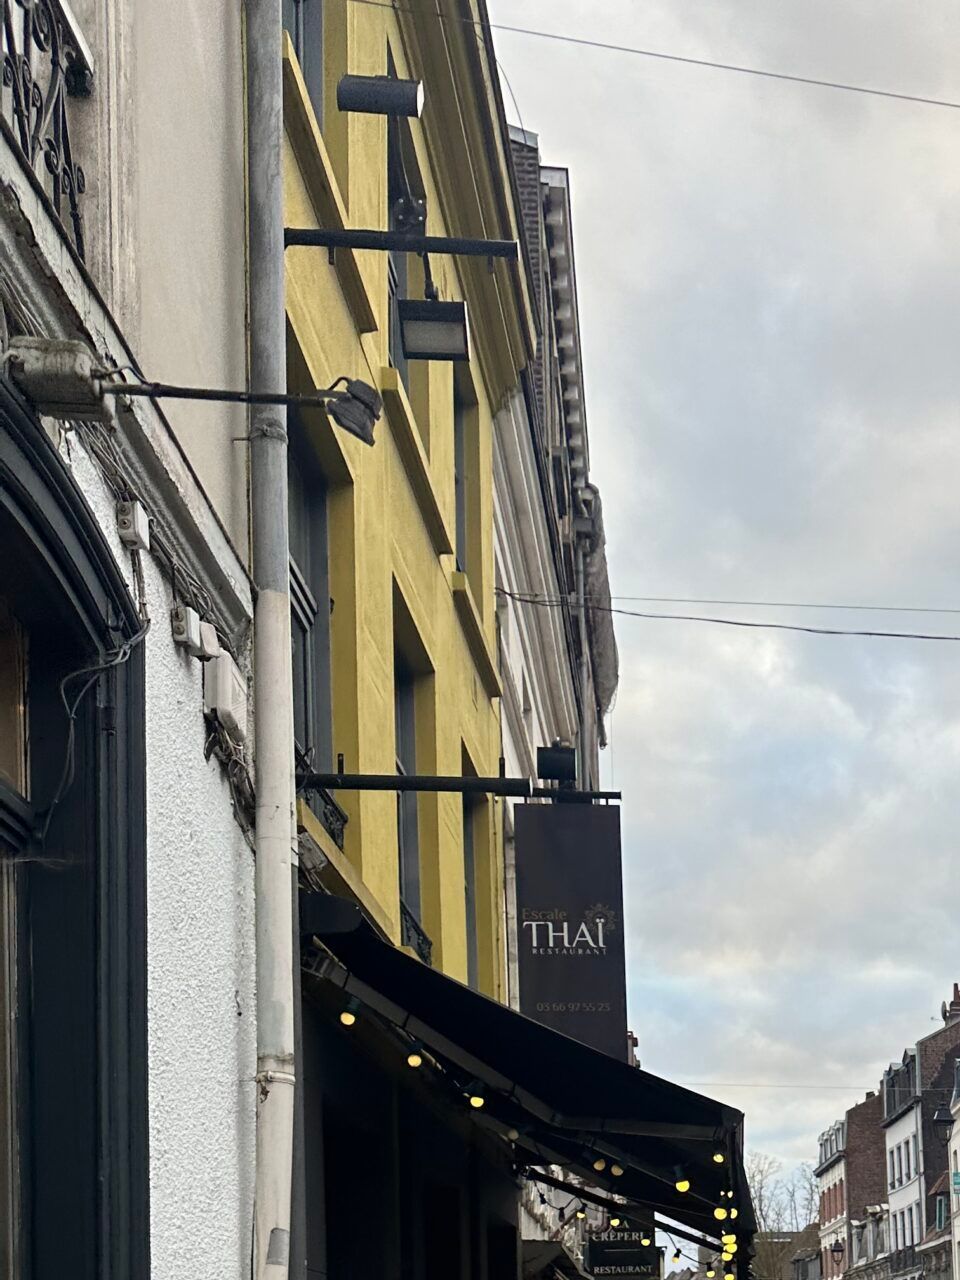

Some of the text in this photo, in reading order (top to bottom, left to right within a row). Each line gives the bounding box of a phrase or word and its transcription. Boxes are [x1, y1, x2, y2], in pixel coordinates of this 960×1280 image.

[522, 907, 567, 920] Escale
[522, 918, 607, 947] THAÏ
[532, 947, 607, 956] RESTAURANT
[536, 1002, 550, 1012] 03
[592, 1230, 648, 1242] CRÊPERI
[593, 1265, 652, 1274] RESTAURANT
